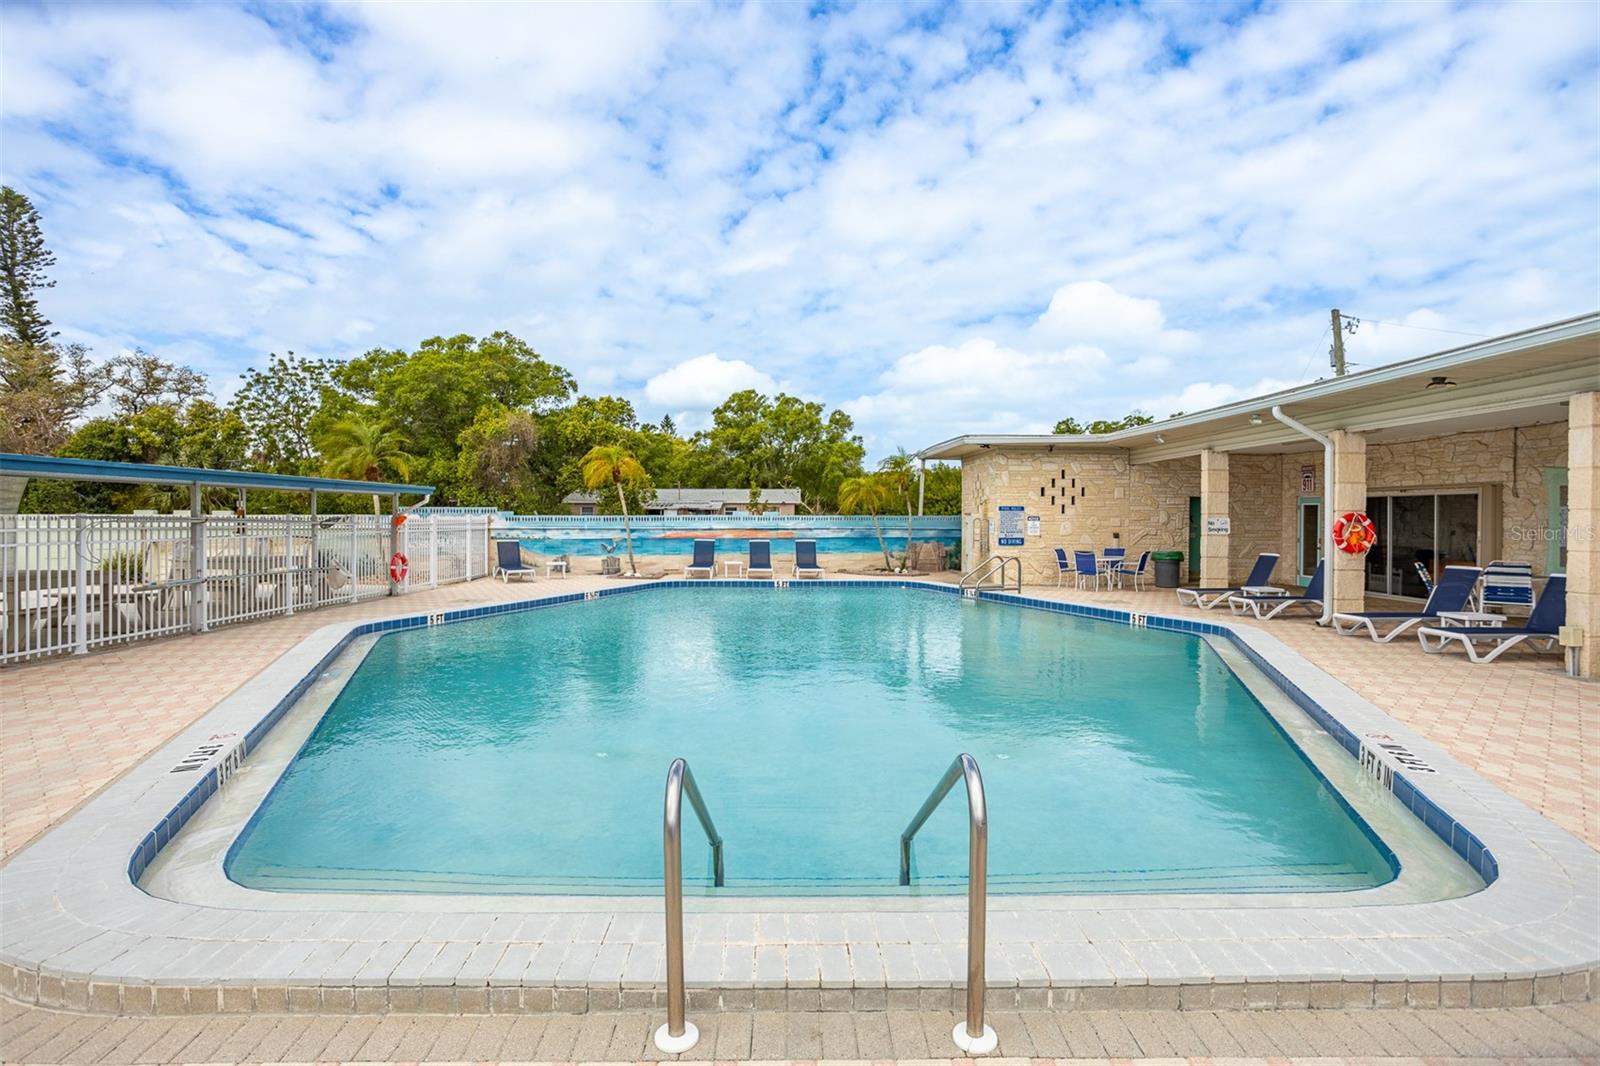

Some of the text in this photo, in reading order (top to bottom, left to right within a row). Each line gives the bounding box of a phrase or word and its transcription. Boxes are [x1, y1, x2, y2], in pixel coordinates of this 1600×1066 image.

[1302, 479, 1313, 491] 911
[436, 614, 443, 625] FT
[1138, 615, 1146, 625] FT
[1366, 750, 1376, 774] FT
[1376, 760, 1382, 781] 6
[1383, 764, 1393, 791] IN
